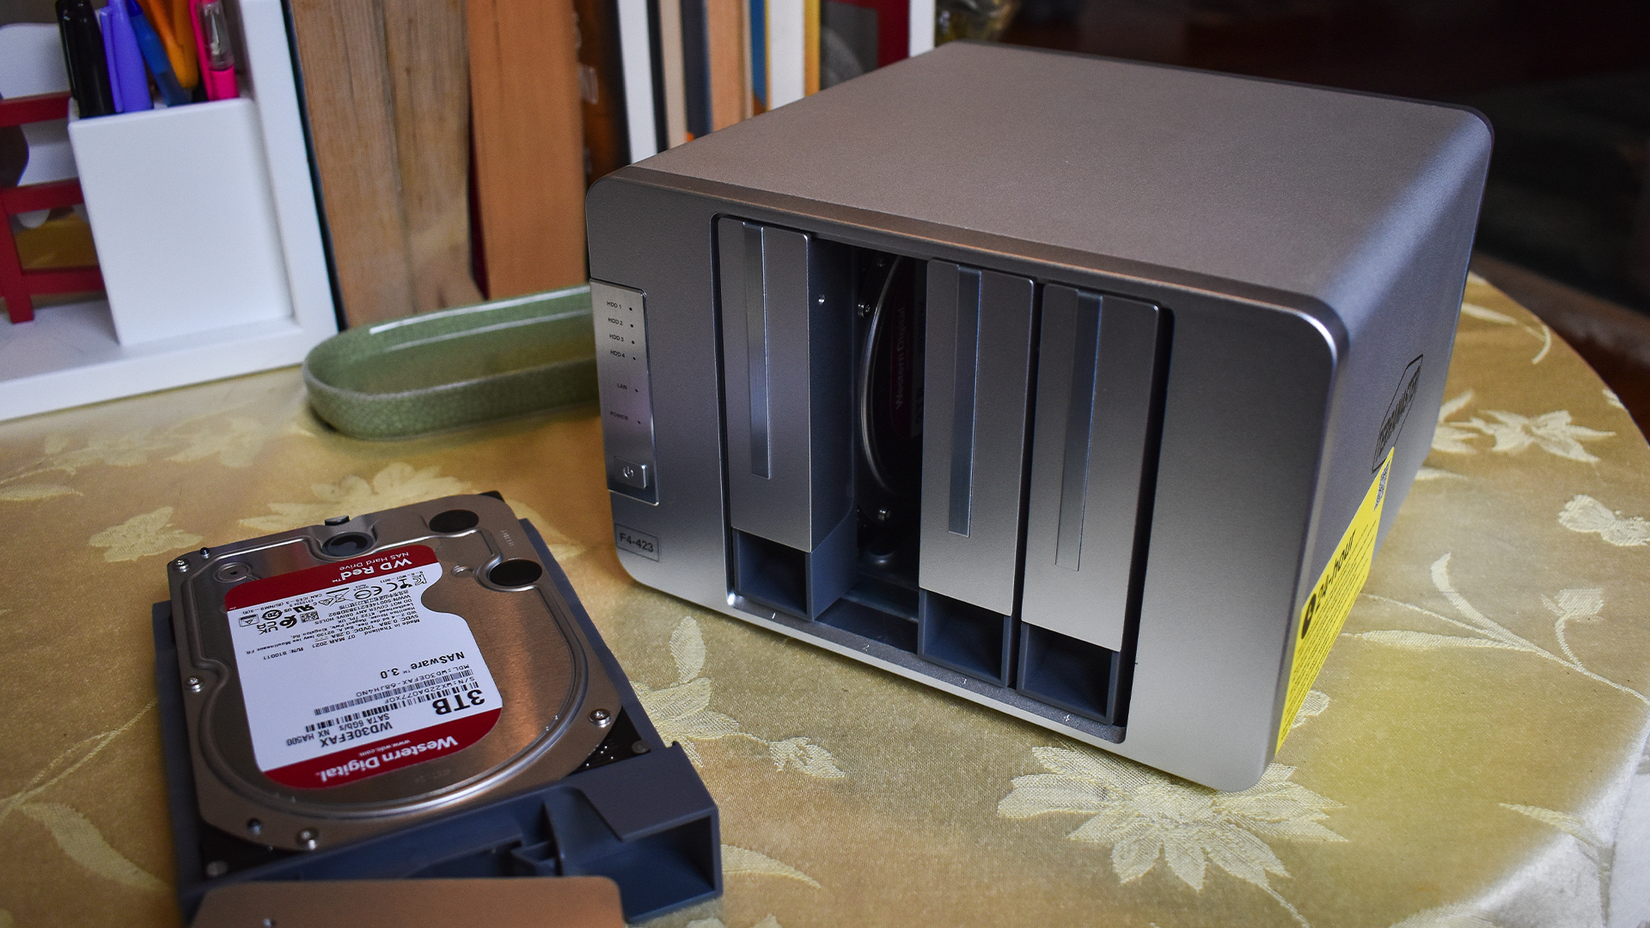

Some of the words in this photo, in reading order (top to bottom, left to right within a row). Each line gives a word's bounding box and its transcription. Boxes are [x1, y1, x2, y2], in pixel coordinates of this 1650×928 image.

[606, 301, 618, 309] HDD
[607, 317, 619, 325] HDD
[609, 333, 621, 341] HDD
[610, 349, 622, 357] HDD
[616, 382, 628, 390] LAN
[609, 410, 629, 420] POWER
[619, 532, 654, 553] F4-423
[389, 551, 409, 560] NAS
[365, 556, 388, 565] Hard
[378, 557, 412, 571] WD
[339, 562, 363, 571] Drive
[369, 604, 389, 612] COVER
[335, 612, 354, 620] DRIVE
[314, 617, 334, 625] HOLES
[402, 618, 421, 626] Made
[364, 625, 392, 636] Thailand
[312, 640, 328, 648] 2021
[329, 636, 345, 644] MAR
[379, 667, 401, 680] 3.0
[430, 688, 487, 717] 3TB
[366, 712, 390, 725] SATA
[338, 719, 364, 733] 6Gb/s
[317, 728, 330, 738] NX
[319, 721, 393, 748] WD30EFAX
[286, 732, 315, 746] HA500
[358, 739, 411, 757] www.wdc.com
[380, 734, 458, 765] Western
[319, 753, 381, 782] Digital
